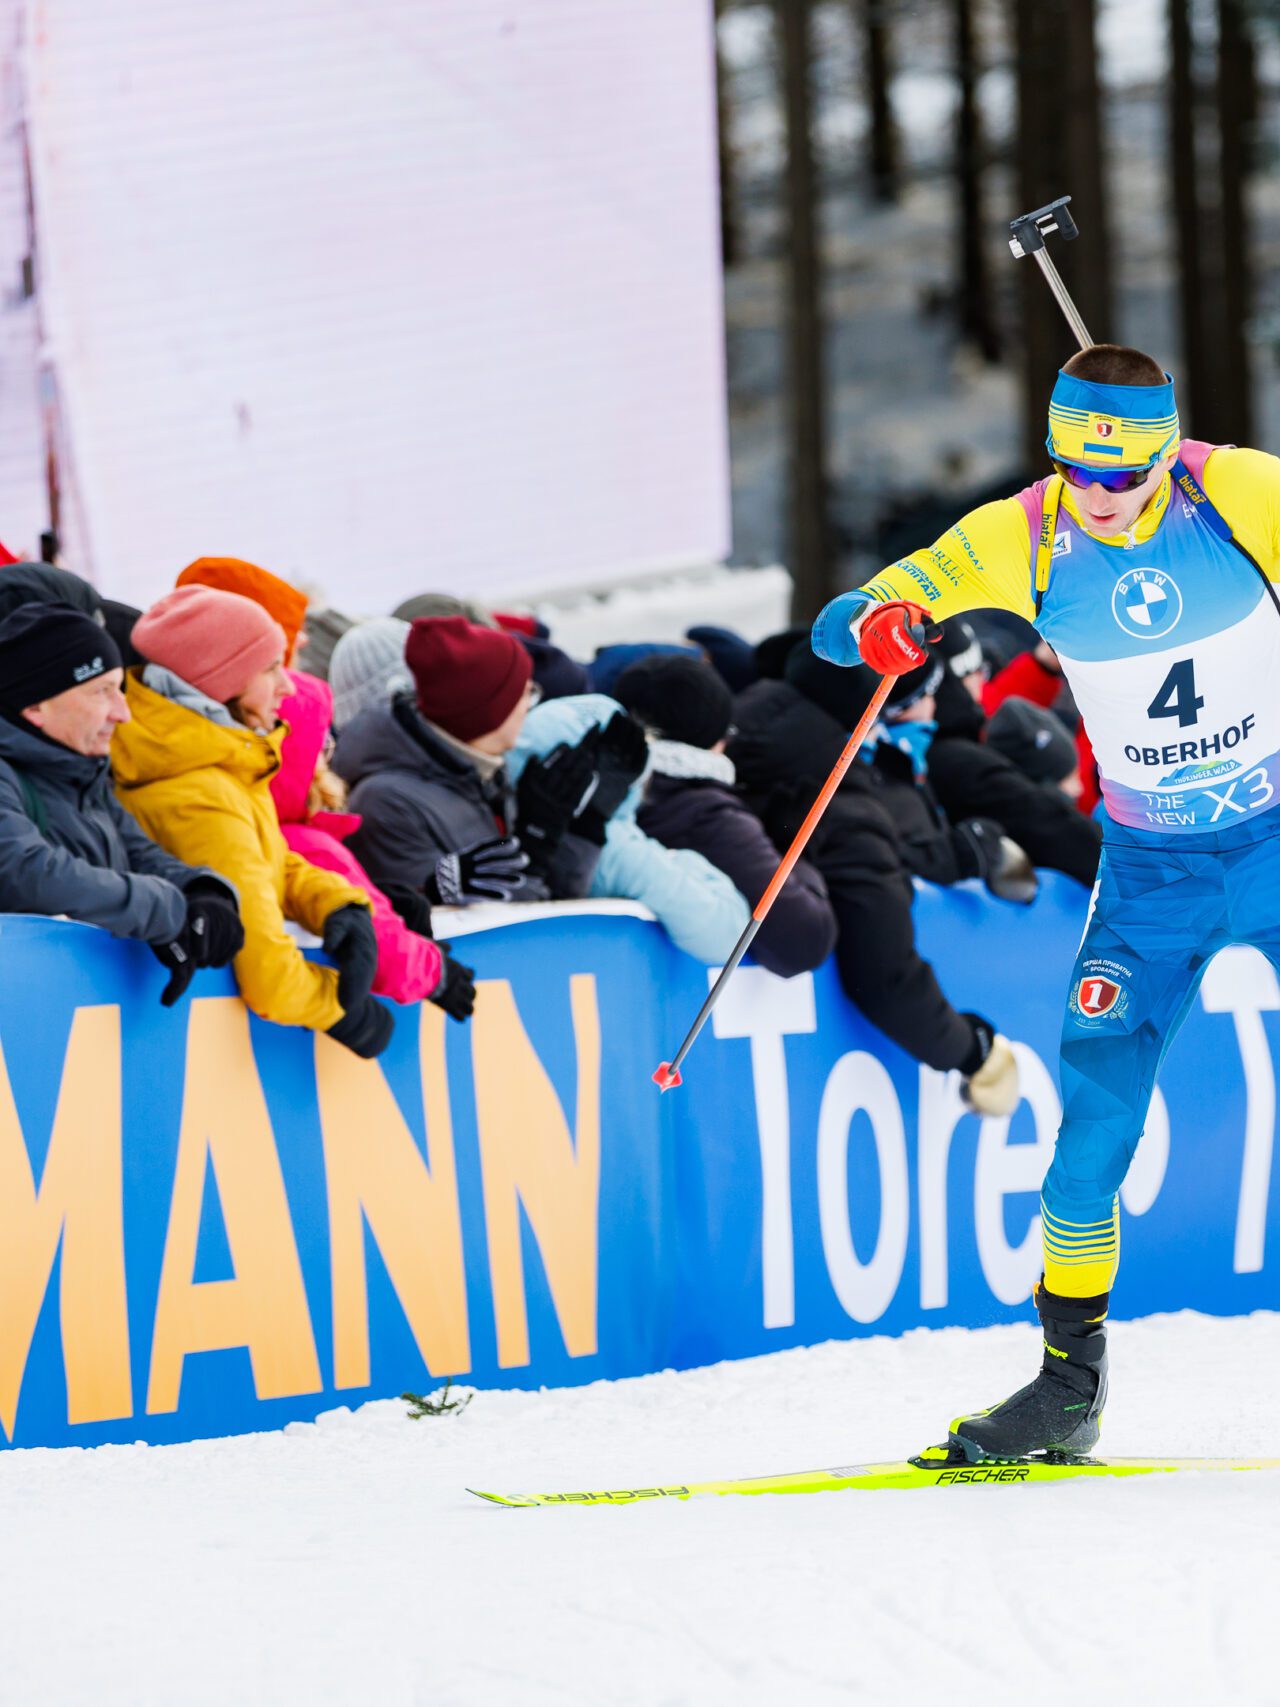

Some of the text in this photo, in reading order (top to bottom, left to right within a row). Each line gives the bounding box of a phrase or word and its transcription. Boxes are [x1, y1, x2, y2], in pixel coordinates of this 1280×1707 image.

[1147, 658, 1205, 728] 4
[1124, 713, 1256, 766] OBERHOF
[1141, 792, 1187, 810] THE
[1202, 767, 1275, 823] X3
[1146, 811, 1196, 826] NEW
[1084, 983, 1103, 1009] 1
[936, 1468, 1030, 1485] FISCHER
[543, 1485, 690, 1503] FISCHER
